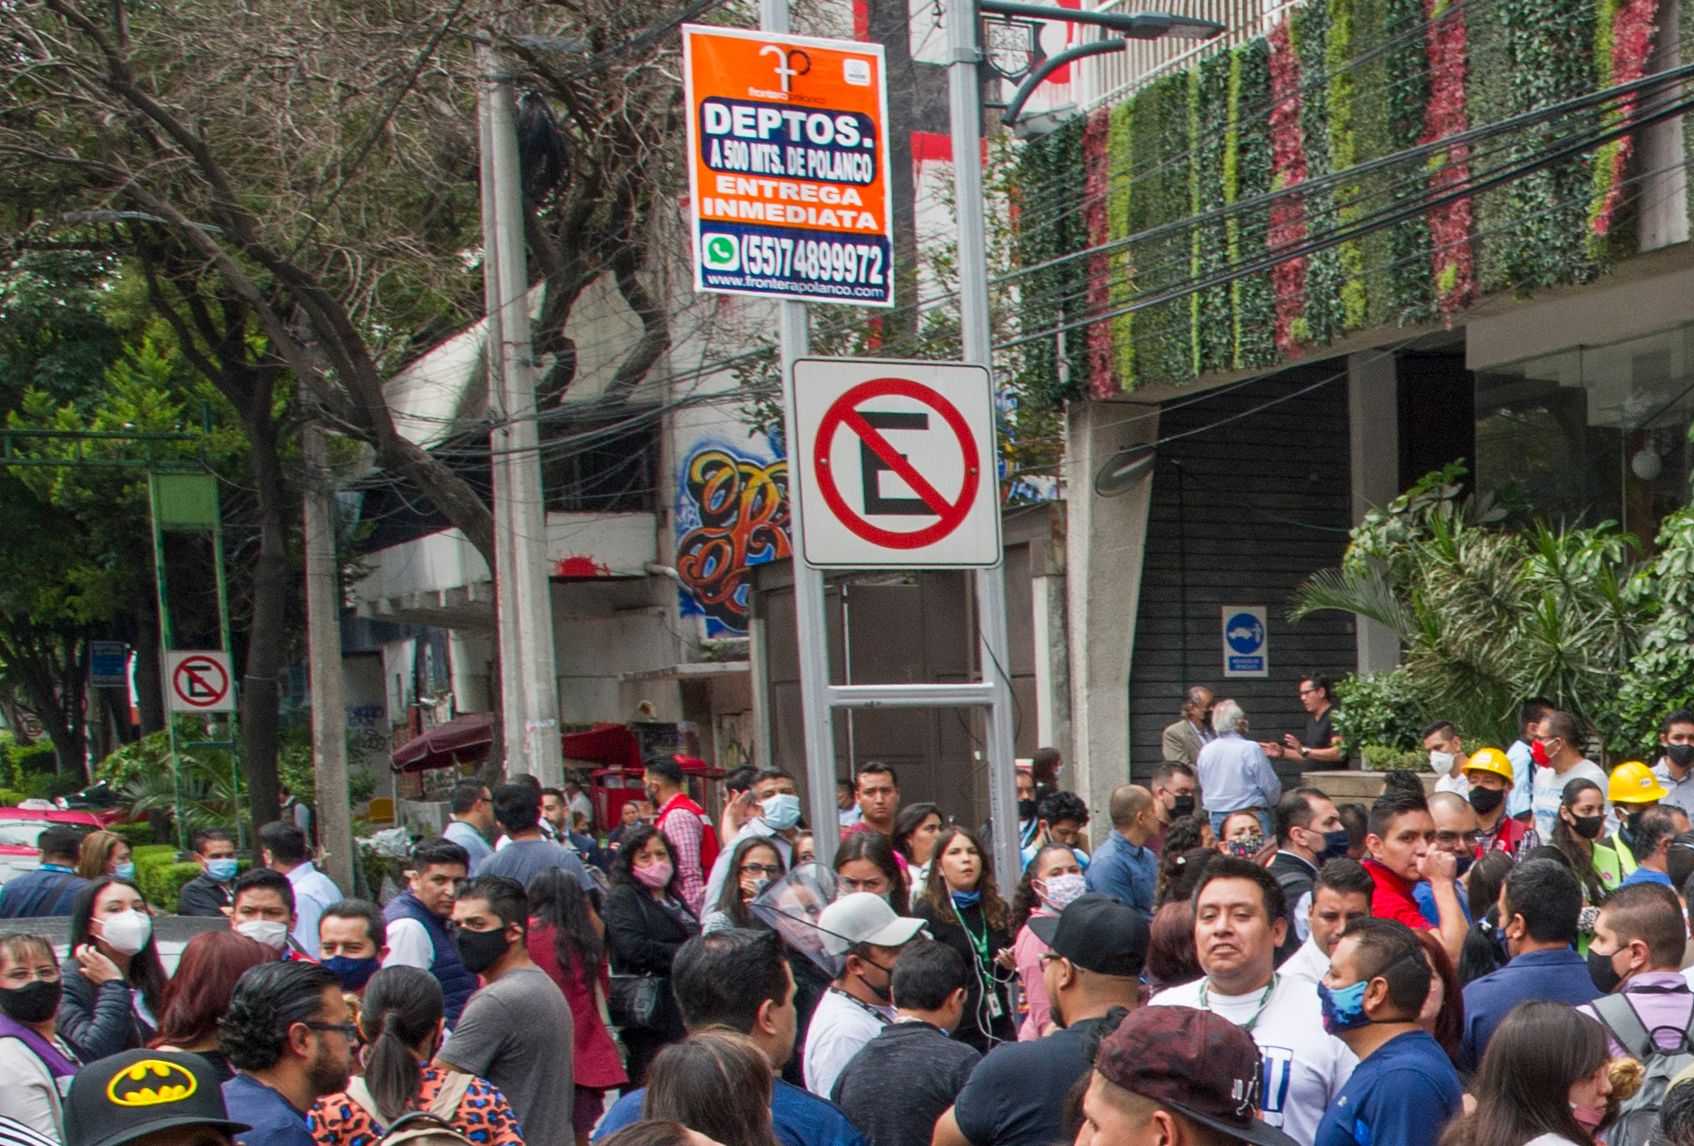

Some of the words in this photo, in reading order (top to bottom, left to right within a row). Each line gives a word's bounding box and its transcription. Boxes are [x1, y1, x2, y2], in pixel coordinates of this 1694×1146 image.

[704, 103, 874, 149] DEPTOS.
[711, 139, 723, 168] A
[724, 140, 749, 171] 500
[752, 143, 785, 175] MTS.
[787, 148, 806, 176] DE
[808, 149, 872, 184] POLANCO
[716, 176, 863, 206] ENTREGA
[703, 199, 878, 230] INMEDIATA
[741, 235, 882, 284] (55)74899972
[708, 274, 884, 298] www.fronterapolanco.com
